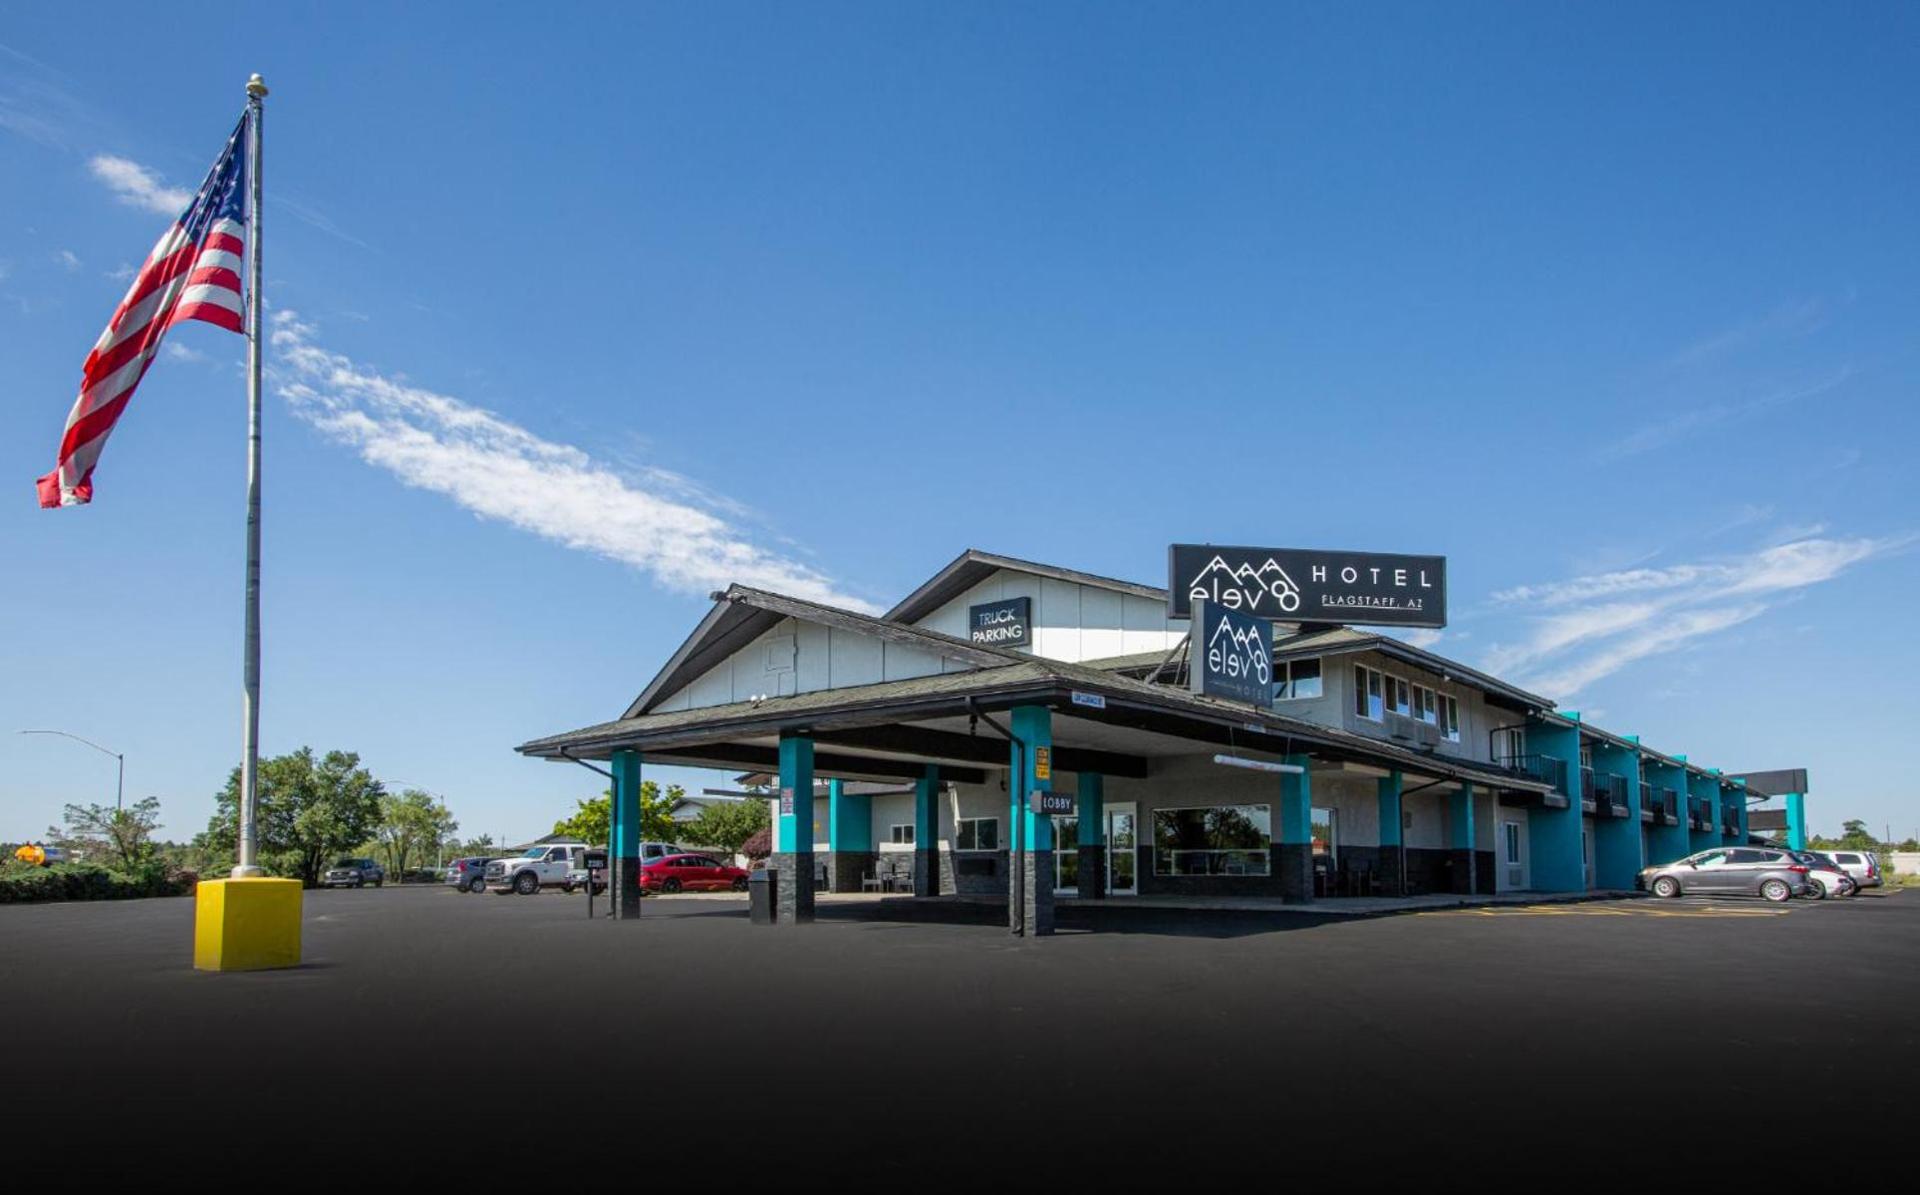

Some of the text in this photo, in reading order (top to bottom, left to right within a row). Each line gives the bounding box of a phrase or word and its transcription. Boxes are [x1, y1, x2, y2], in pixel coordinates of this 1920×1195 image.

[1312, 565, 1432, 588] HOTEL
[1321, 594, 1424, 609] FLAGSTAFF, AZ
[979, 608, 1015, 626] TRUCK
[972, 624, 1022, 643] PARKING
[1043, 796, 1072, 810] LOBBY
